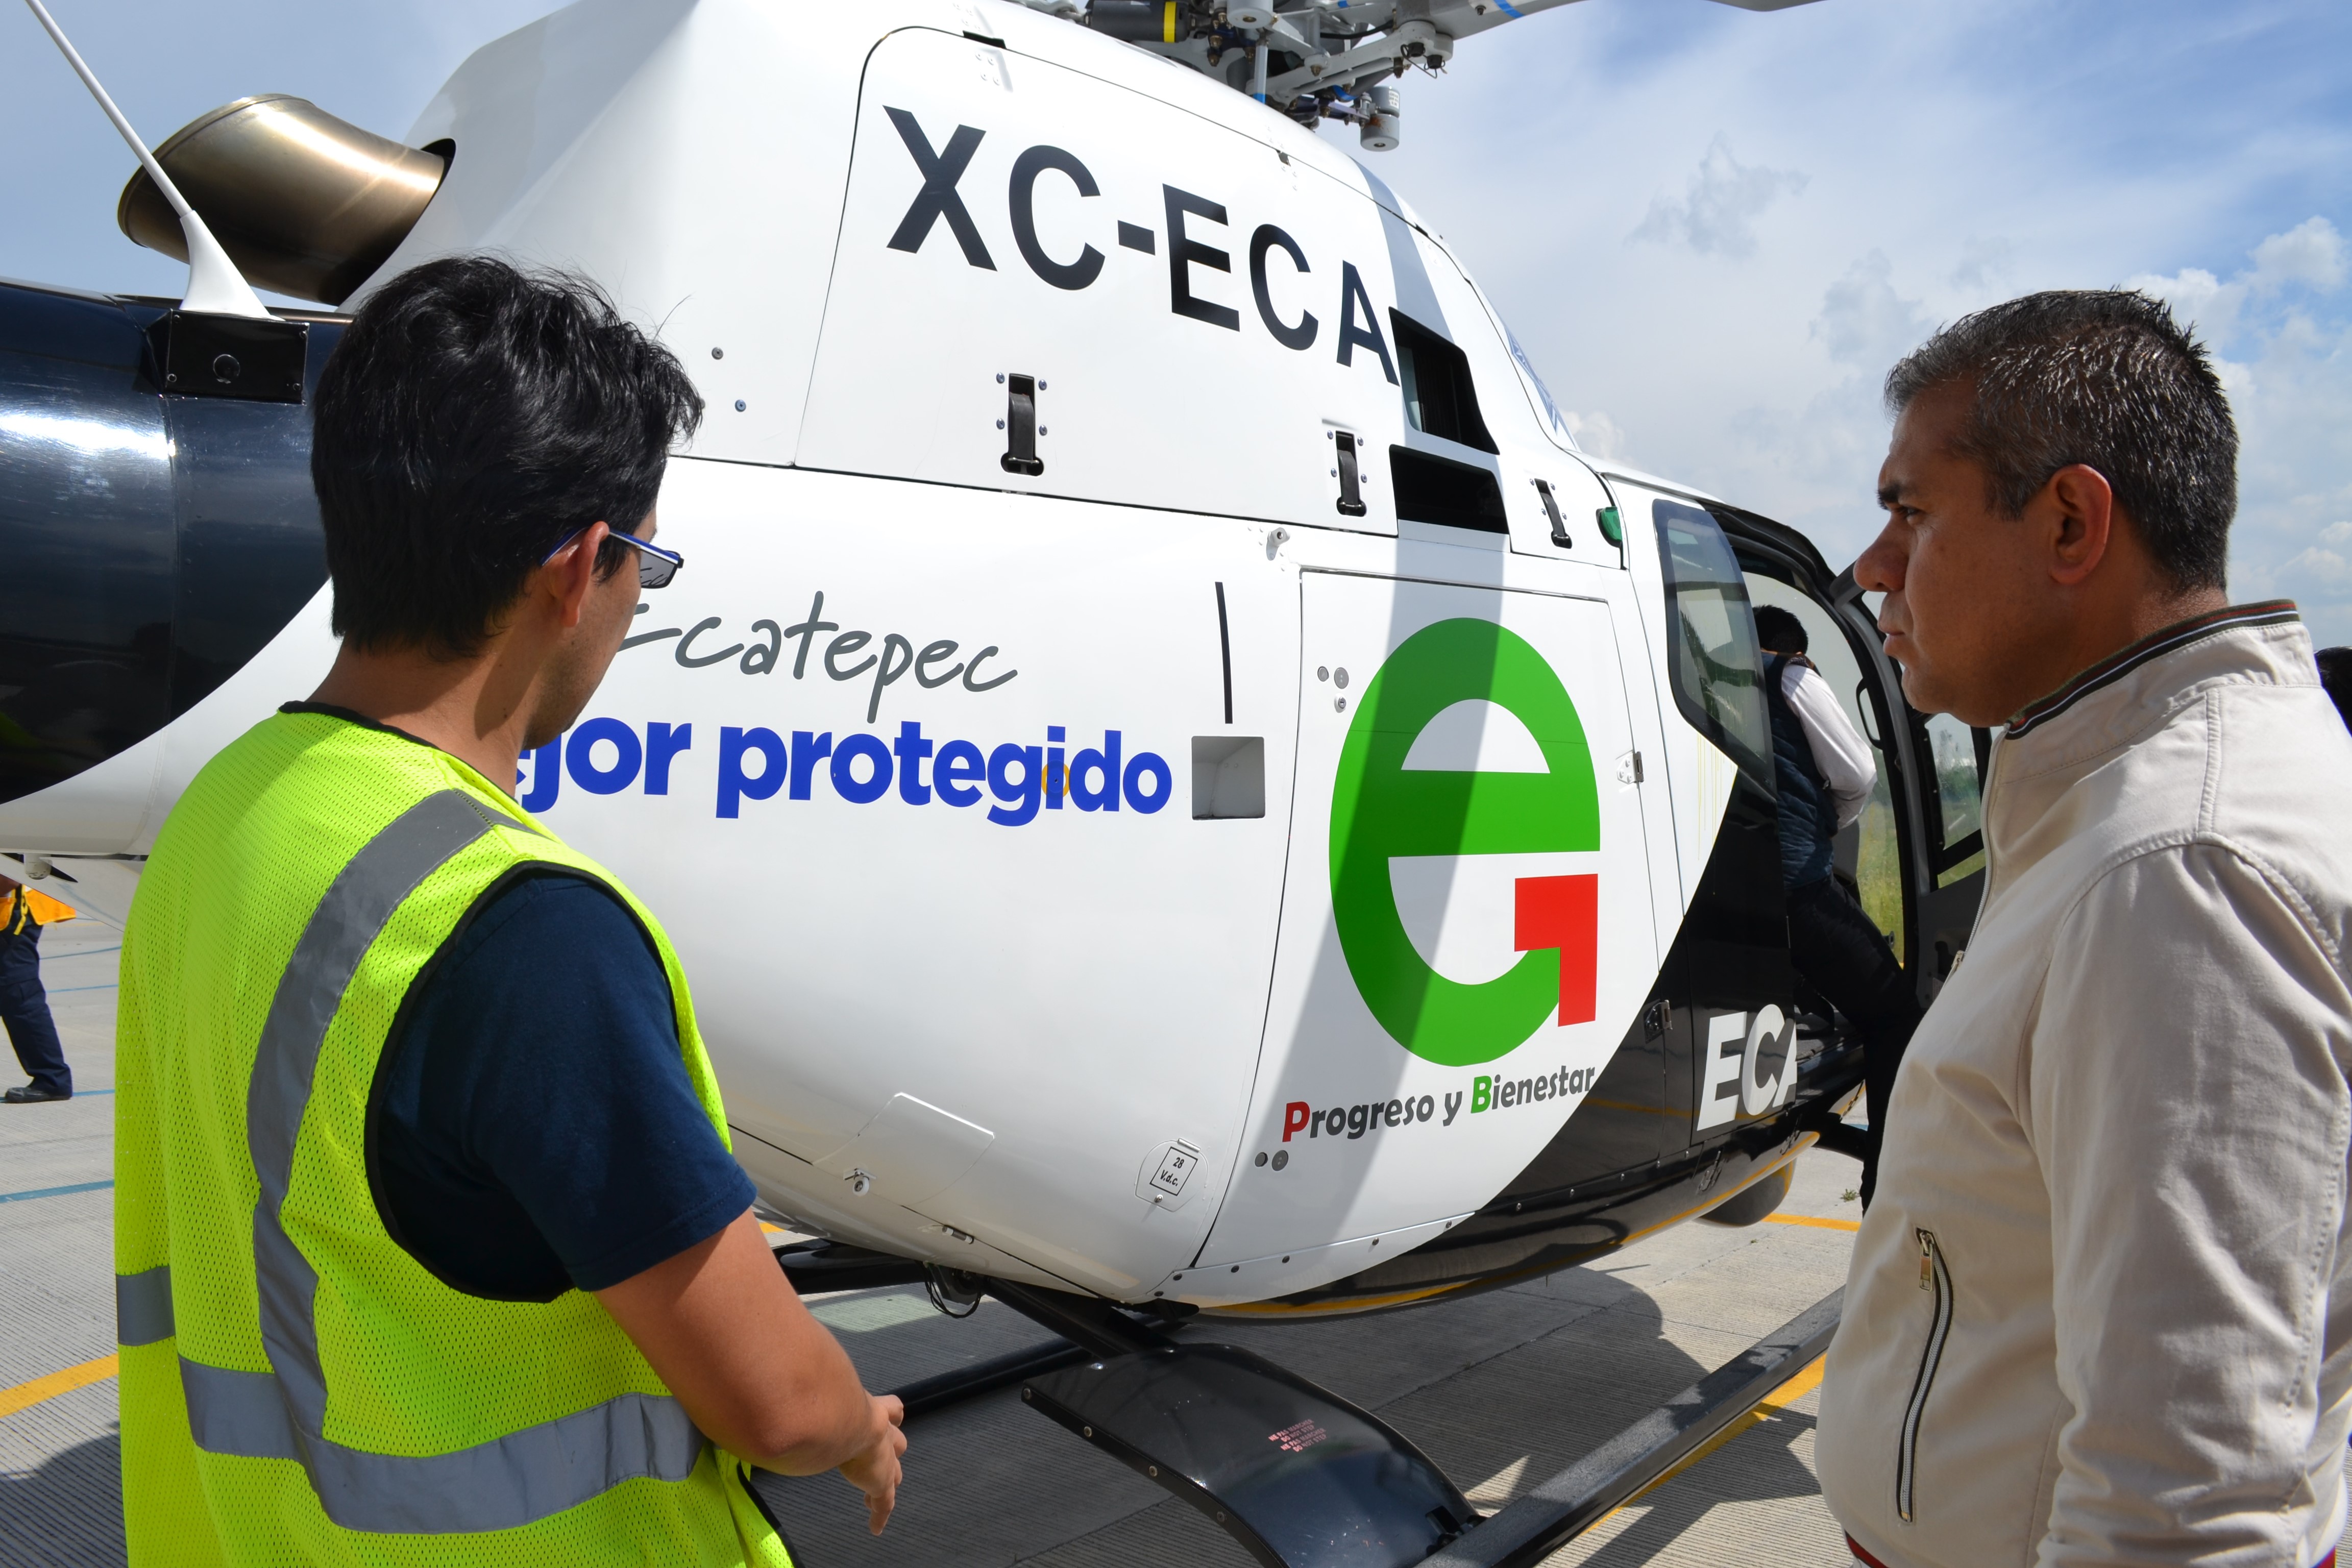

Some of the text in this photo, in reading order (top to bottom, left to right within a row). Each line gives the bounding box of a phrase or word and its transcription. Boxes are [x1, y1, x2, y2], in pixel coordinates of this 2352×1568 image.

[883, 105, 1400, 386] XC-ECA
[516, 717, 1172, 827] jor protegido
[1282, 1065, 1596, 1142] Progreso y Bienestar
[1172, 1157, 1185, 1169] 28
[1313, 1434, 1327, 1442] STEP
